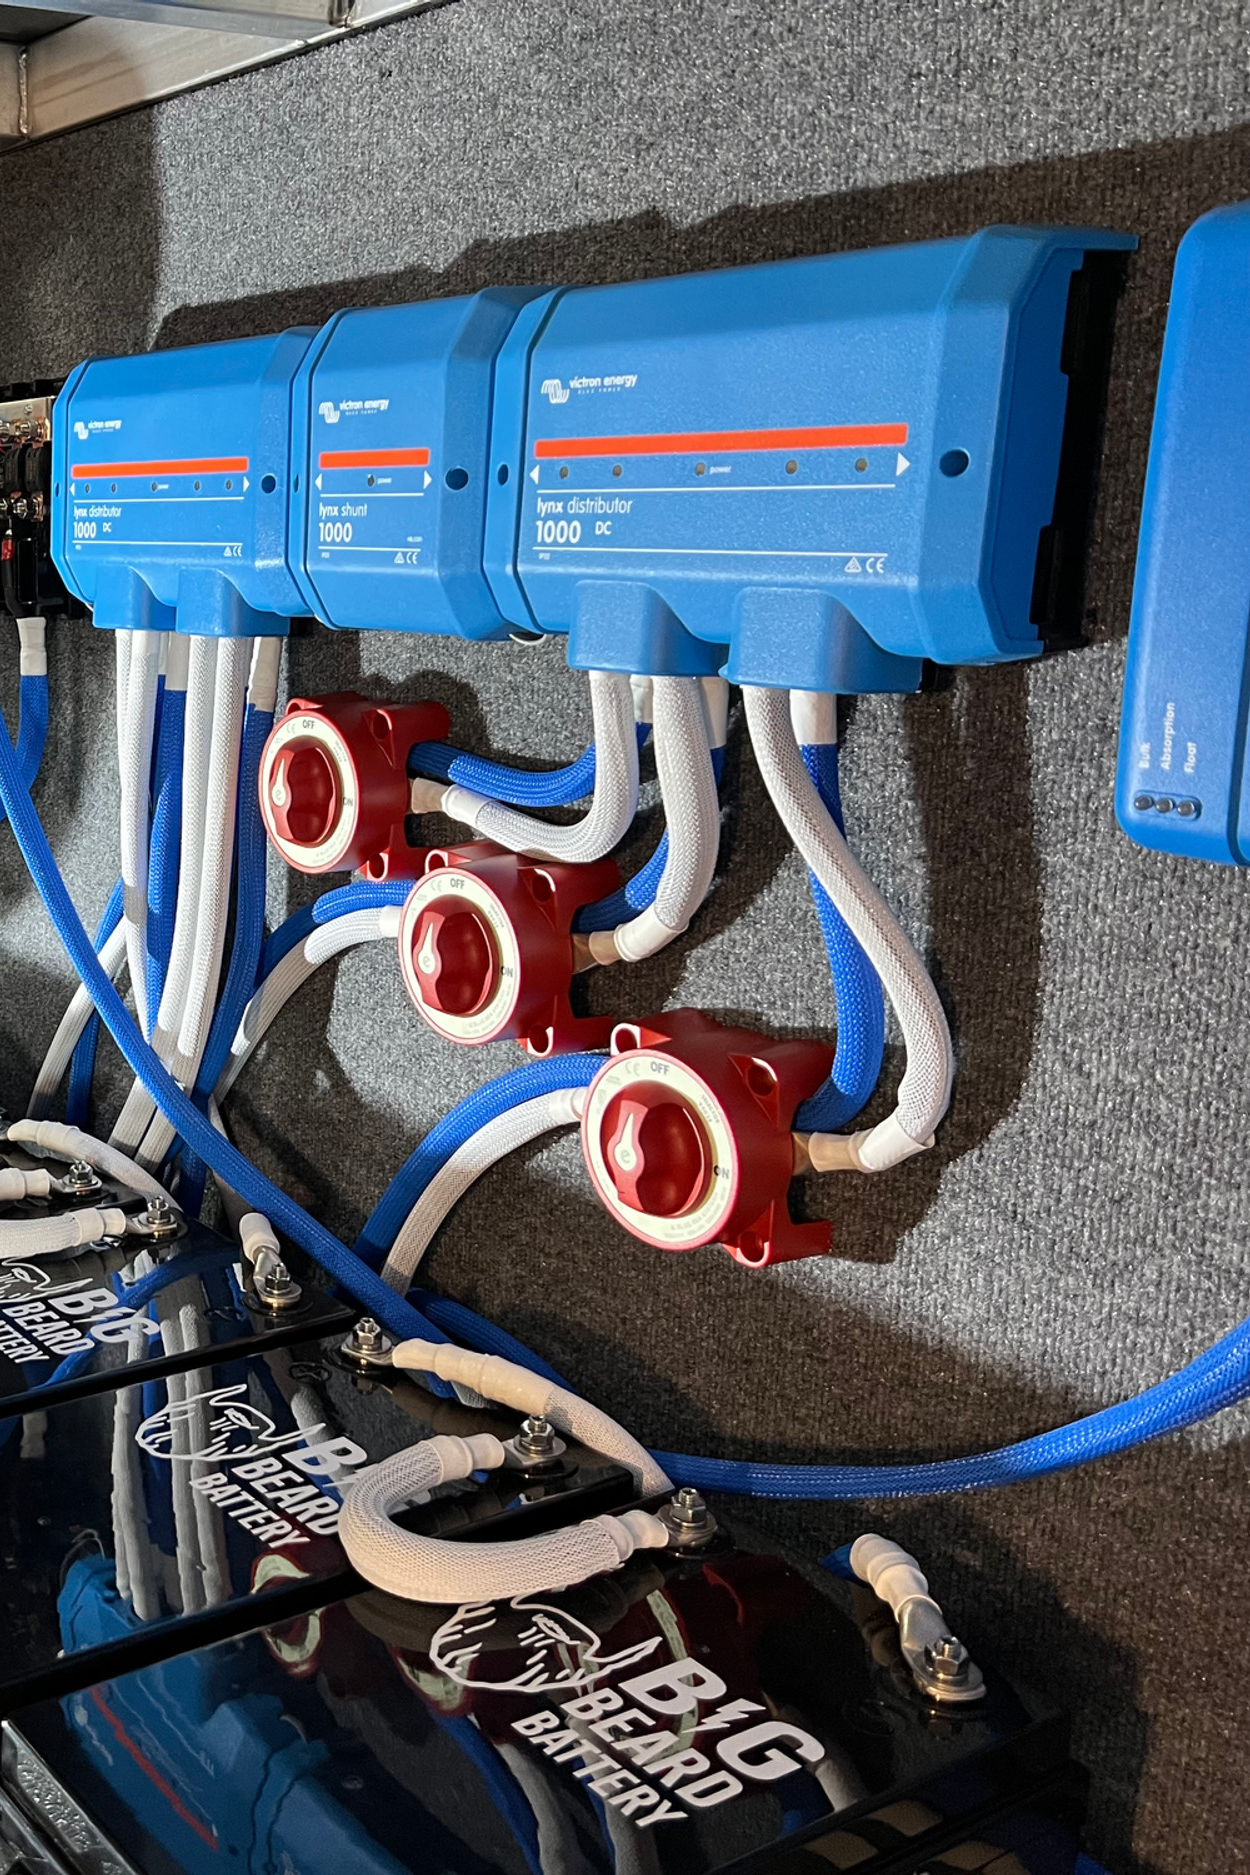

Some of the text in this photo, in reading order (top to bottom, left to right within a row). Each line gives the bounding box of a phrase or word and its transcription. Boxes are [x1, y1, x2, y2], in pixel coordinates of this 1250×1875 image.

[569, 374, 638, 388] victron energy
[364, 398, 390, 411] energy
[73, 504, 122, 520] lynx distributor
[318, 502, 368, 520] lynx shunt
[536, 496, 633, 517] lynx distributor
[73, 521, 97, 538] 1000
[318, 521, 353, 543] 1000
[535, 520, 612, 544] 1000 DC
[302, 720, 315, 730] OFF
[1161, 702, 1176, 770] Absorption
[1139, 742, 1151, 769] Bulk
[1184, 741, 1198, 773] Float
[342, 797, 354, 808] ON
[450, 878, 465, 890] OFF
[501, 966, 514, 978] ON
[650, 1061, 670, 1076] OFF
[714, 1165, 730, 1180] ON
[48, 1287, 160, 1343] BIG
[2, 1301, 95, 1355] BEARD
[188, 1471, 311, 1549] BATTERY
[618, 1656, 826, 1781] BIG
[559, 1687, 744, 1808] BEARD
[510, 1710, 689, 1829] BATTERY
